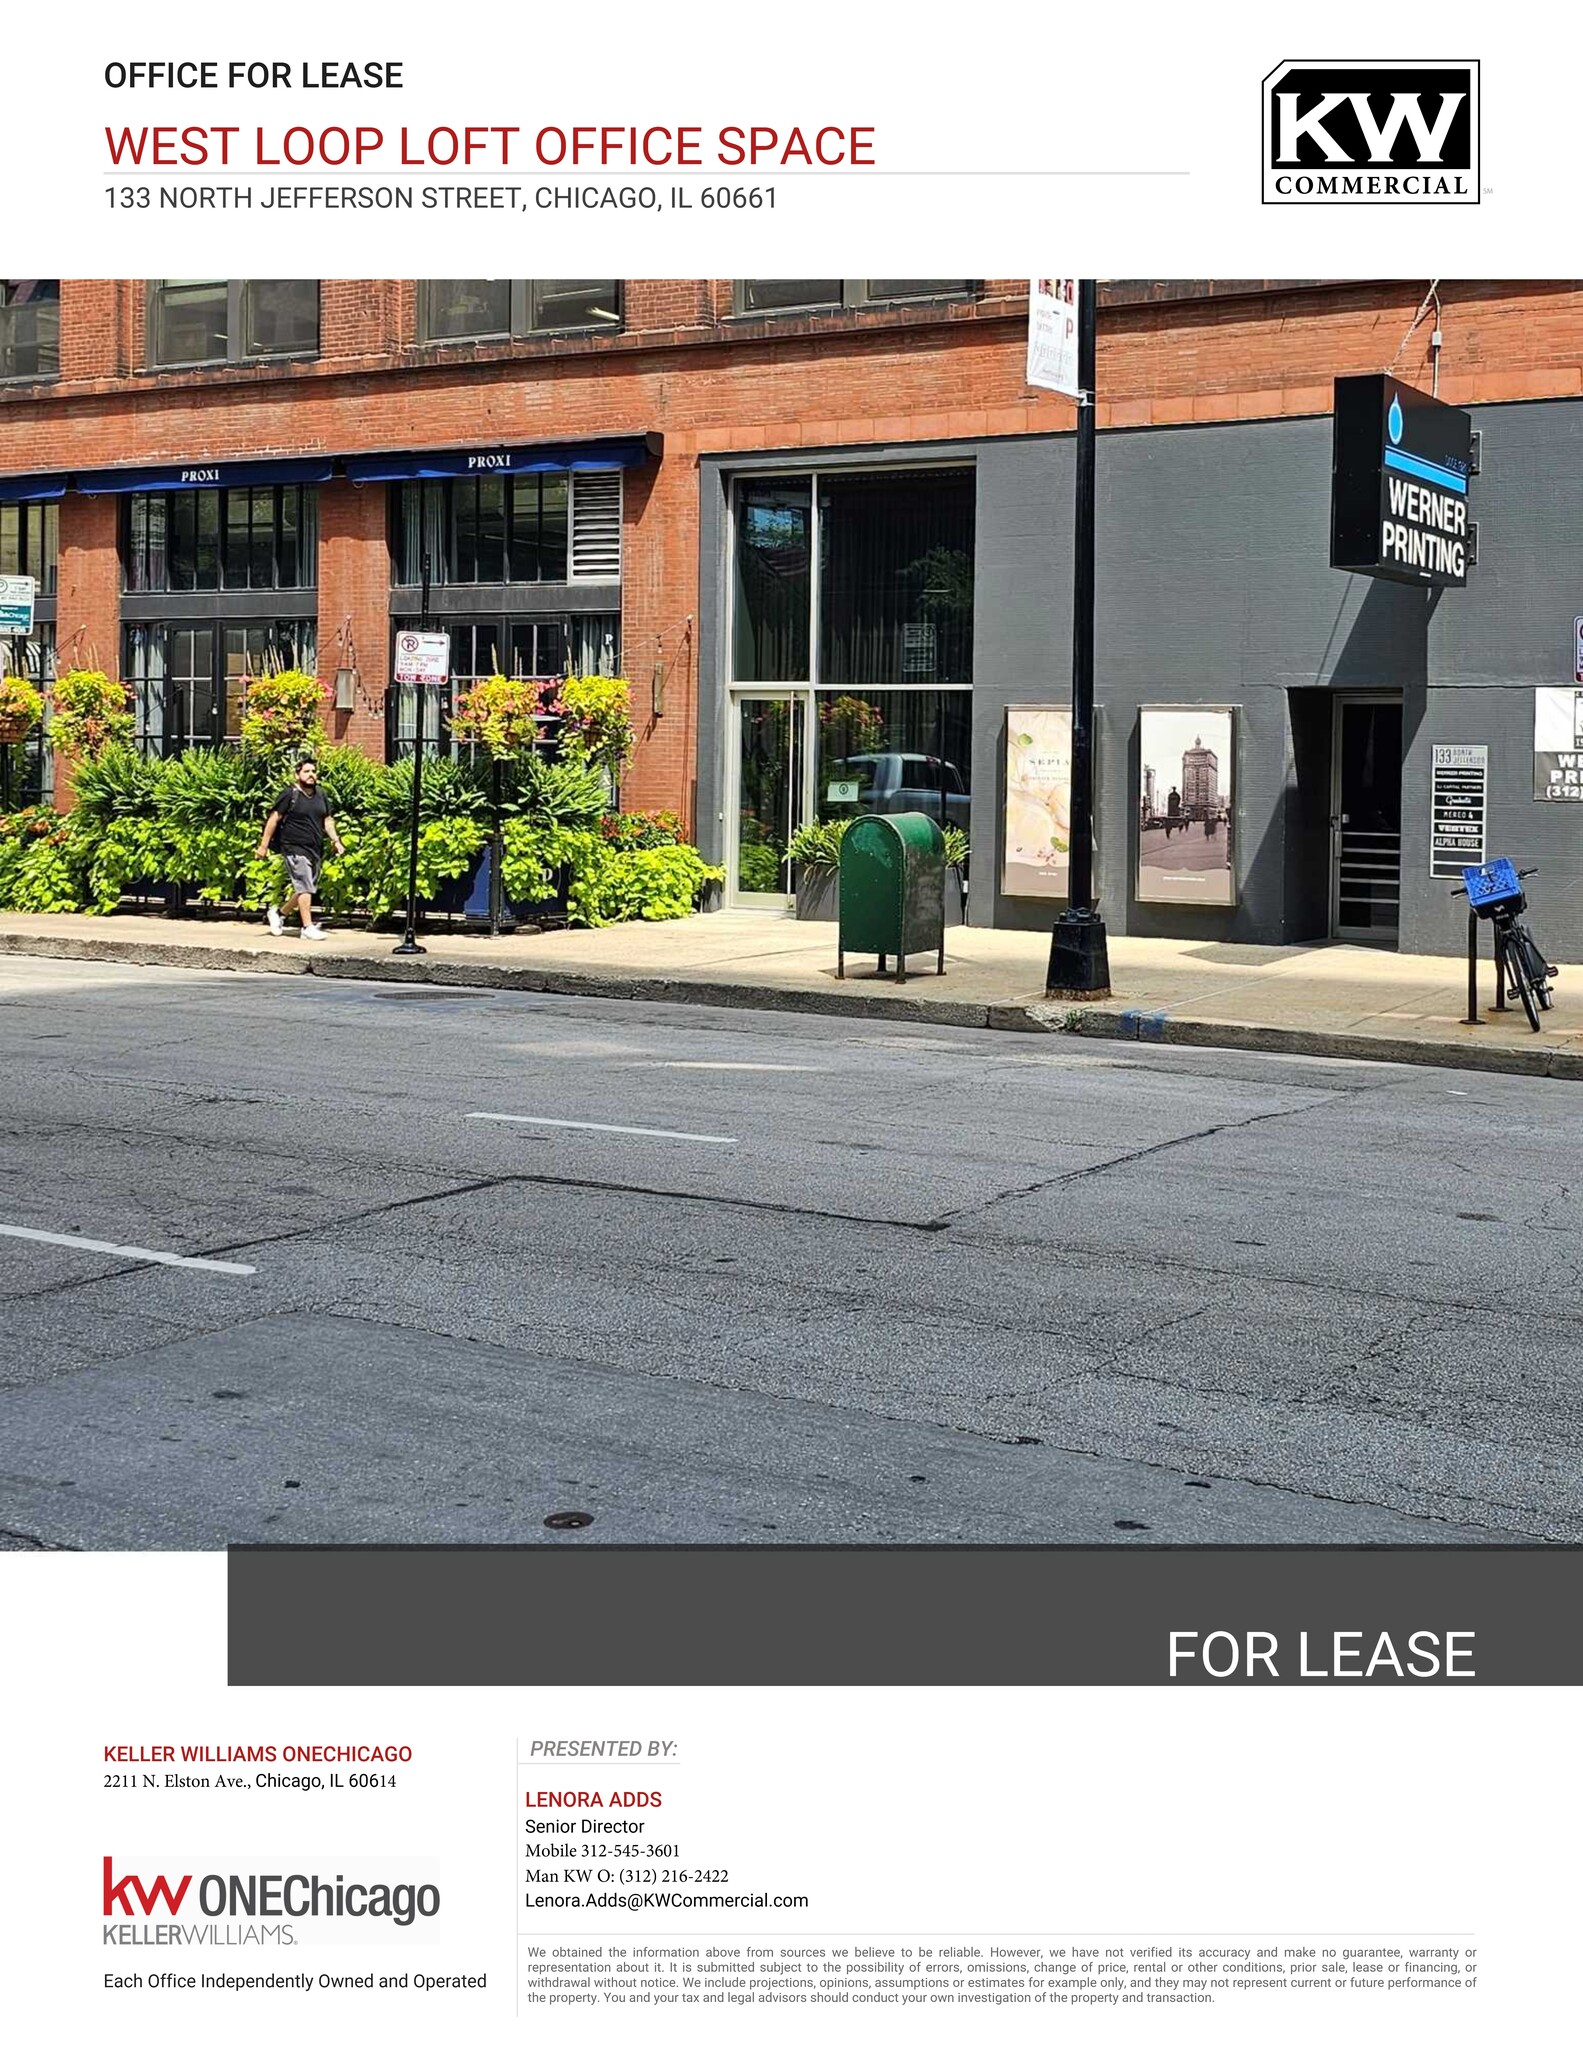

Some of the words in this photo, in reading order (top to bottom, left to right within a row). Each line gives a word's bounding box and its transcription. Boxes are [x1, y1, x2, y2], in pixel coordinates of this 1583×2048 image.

[468, 455, 511, 470] PROXI
[181, 469, 220, 483] PROXI
[1388, 477, 1466, 536] WERNER
[1382, 521, 1465, 577] PRINTING
[1435, 748, 1451, 763] 133
[1434, 837, 1456, 847] ALPHA
